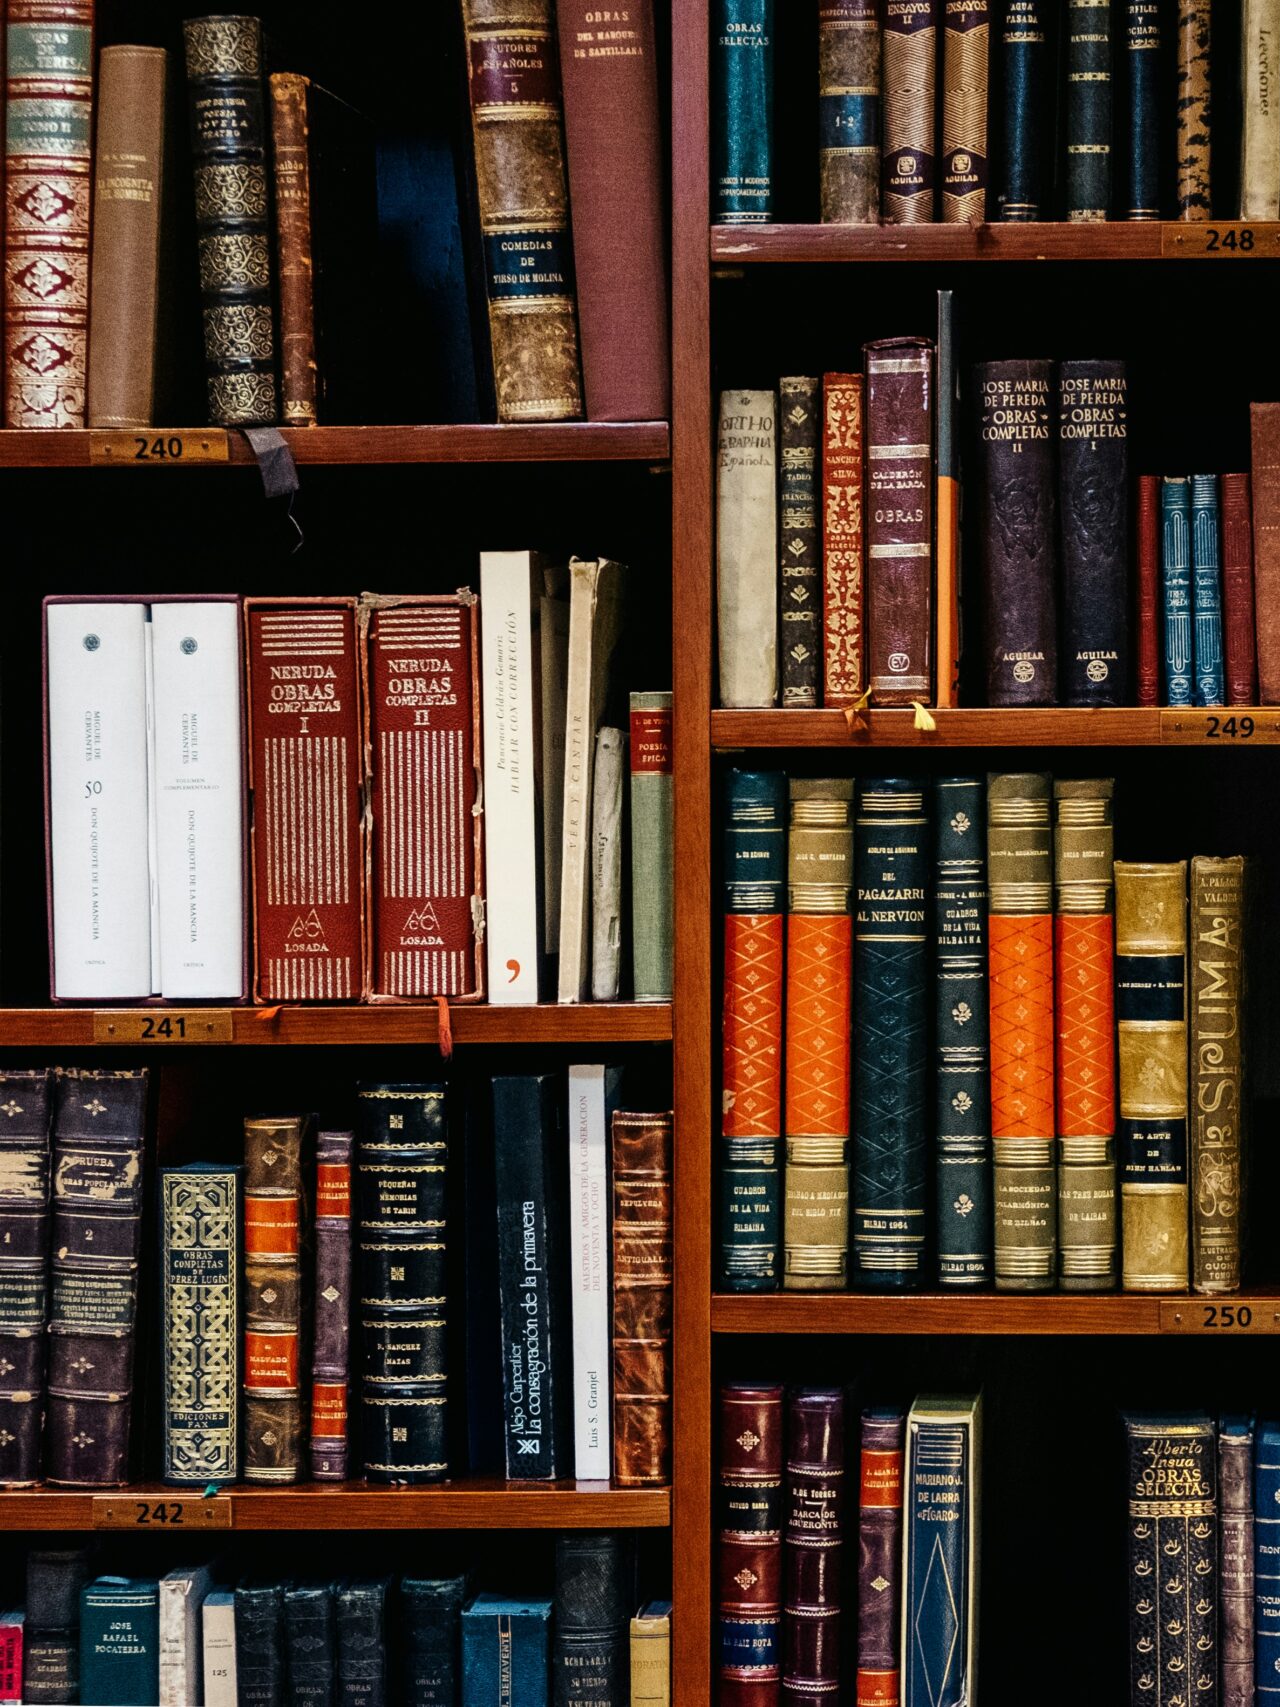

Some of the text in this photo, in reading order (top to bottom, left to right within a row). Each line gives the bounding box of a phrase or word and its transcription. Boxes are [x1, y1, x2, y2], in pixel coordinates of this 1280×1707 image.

[887, 2, 931, 17] ENSAYOS
[585, 11, 630, 24] OBRAS
[726, 23, 762, 34] OBRAS
[718, 36, 770, 48] SELECTAS
[501, 241, 553, 251] COMEDIAS
[1205, 228, 1255, 252] 248
[520, 256, 536, 267] DE
[532, 272, 564, 283] MOLINA
[980, 379, 1049, 394] JOSE MARIA
[1059, 378, 1128, 392] JOSE MARIA
[984, 393, 1047, 408] DE PEREDA
[1062, 392, 1125, 406] DE PEREDA
[992, 409, 1038, 424] OBRAS
[1071, 407, 1116, 423] OBRAS
[981, 424, 1050, 441] COMPLETAS
[1060, 423, 1128, 439] COMPLETAS
[133, 436, 183, 460] 240
[1012, 443, 1023, 453] II
[1090, 441, 1098, 451] I
[874, 509, 924, 523] OBRAS
[504, 611, 519, 700] CORRECCIÓN
[1002, 651, 1045, 662] AGUILAR
[1076, 650, 1119, 661] AGUILAR
[270, 665, 337, 680] NERUDA
[387, 658, 454, 674] NERUDA
[270, 683, 335, 701] OBRAS
[388, 676, 452, 694] OBRAS
[268, 700, 341, 714] COMPLETAS
[386, 694, 458, 707] COMPLETAS
[93, 710, 102, 748] MIGUEL
[190, 712, 199, 749] MIGUEL
[299, 716, 310, 734] I
[1205, 717, 1256, 739] 249
[85, 710, 94, 762] CERVANTES
[182, 712, 190, 765] CERVANTES
[571, 714, 583, 783] CANTAR
[188, 810, 196, 831] DON
[188, 832, 196, 872] QUIJOTE
[90, 807, 100, 940] DON QUIJOTE DE MANCHA
[189, 874, 197, 887] DE
[857, 888, 926, 900] PAGAZARRI
[856, 910, 926, 922] AL NERVION
[284, 943, 329, 953] LOSADA
[400, 935, 445, 946] LOSADA
[141, 1016, 187, 1038] 241
[1196, 919, 1239, 1150] ESPUMA
[3, 1232, 12, 1244] 1
[84, 1229, 94, 1241] 2
[183, 1251, 213, 1260] OBRAS
[173, 1259, 224, 1269] COMPLETAS
[170, 1272, 229, 1285] PÉREZ LUGÍN
[519, 1200, 546, 1435] La consagración de la primavera
[1202, 1306, 1252, 1328] 250
[508, 1342, 528, 1435] Alejo Carpentier
[173, 1412, 226, 1422] EDICIONES
[586, 1371, 600, 1449] Luis S. Granjel
[1141, 1438, 1204, 1455] Alberto
[1150, 1454, 1195, 1469] Insua
[1141, 1468, 1204, 1484] OBRAS
[1135, 1481, 1211, 1498] SELECTAS
[917, 1491, 961, 1504] DE LARRA
[136, 1502, 184, 1524] 242
[103, 1633, 140, 1643] RAFAEL
